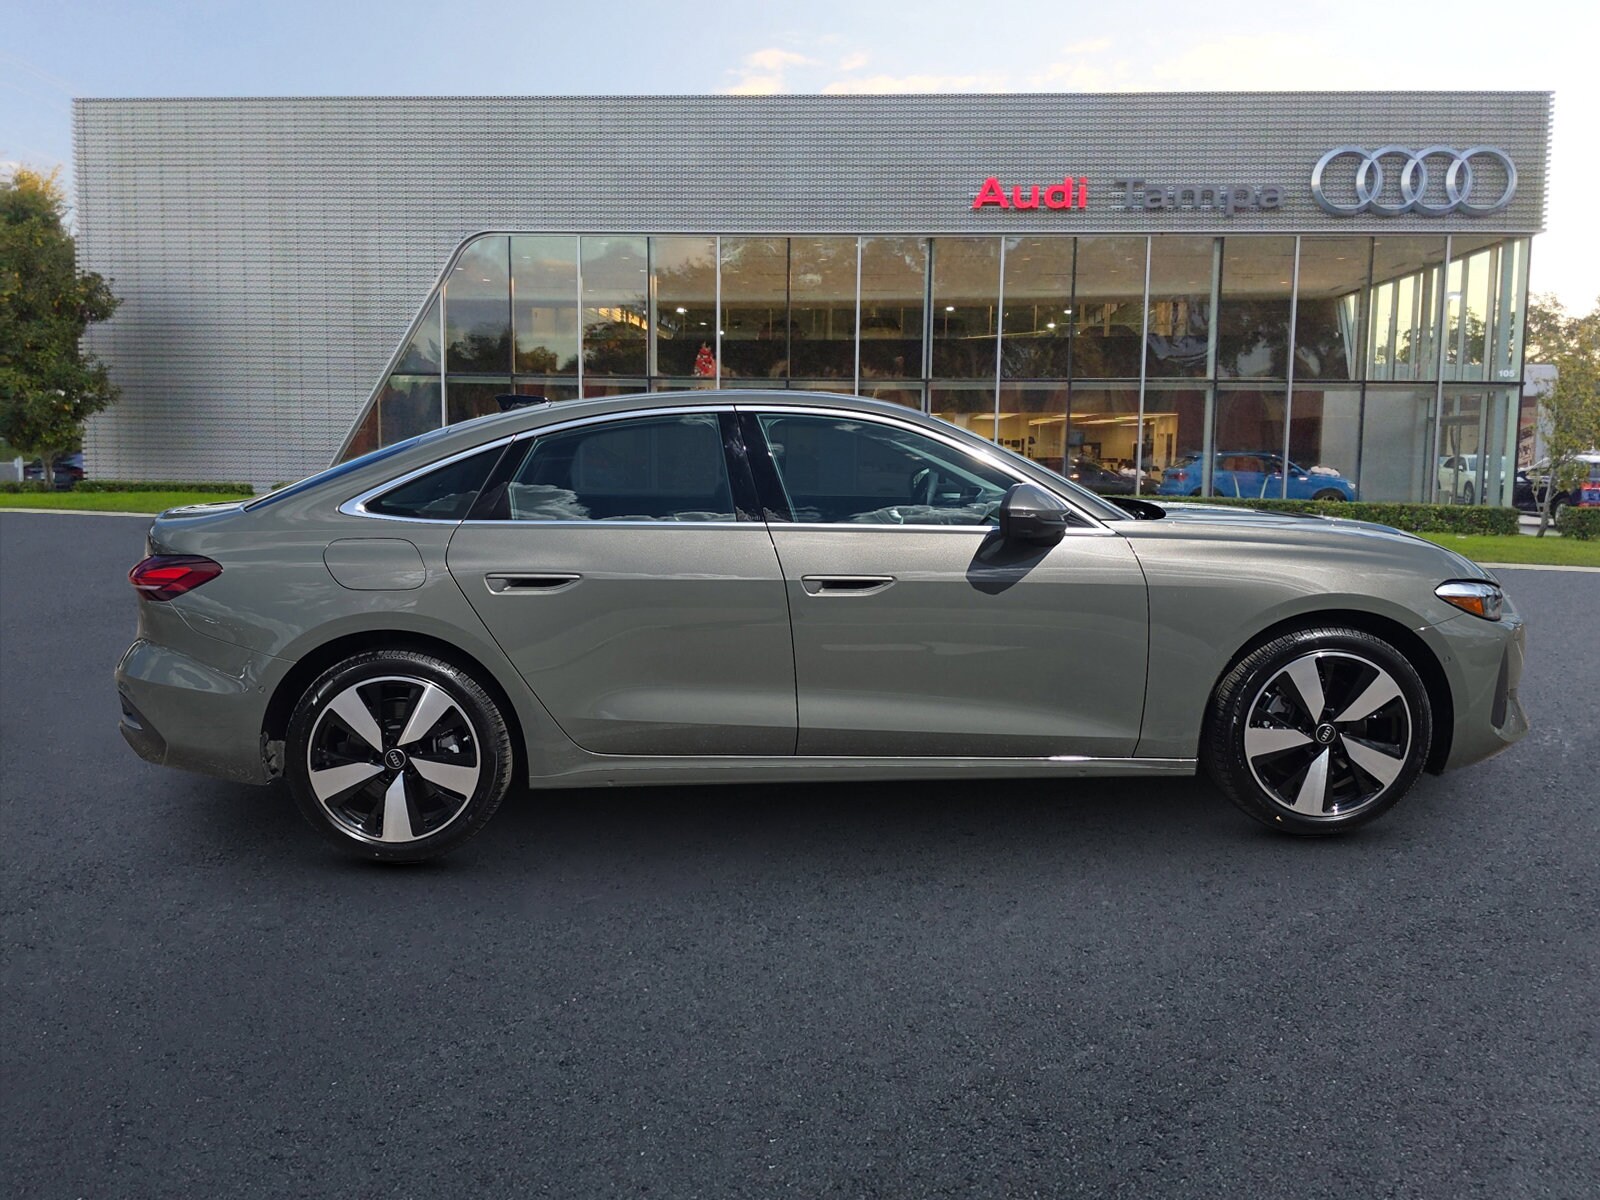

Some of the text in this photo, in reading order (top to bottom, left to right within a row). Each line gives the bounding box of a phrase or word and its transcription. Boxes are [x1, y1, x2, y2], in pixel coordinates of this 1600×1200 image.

[972, 176, 1287, 218] Audi Tampa
[1499, 369, 1515, 378] 105
